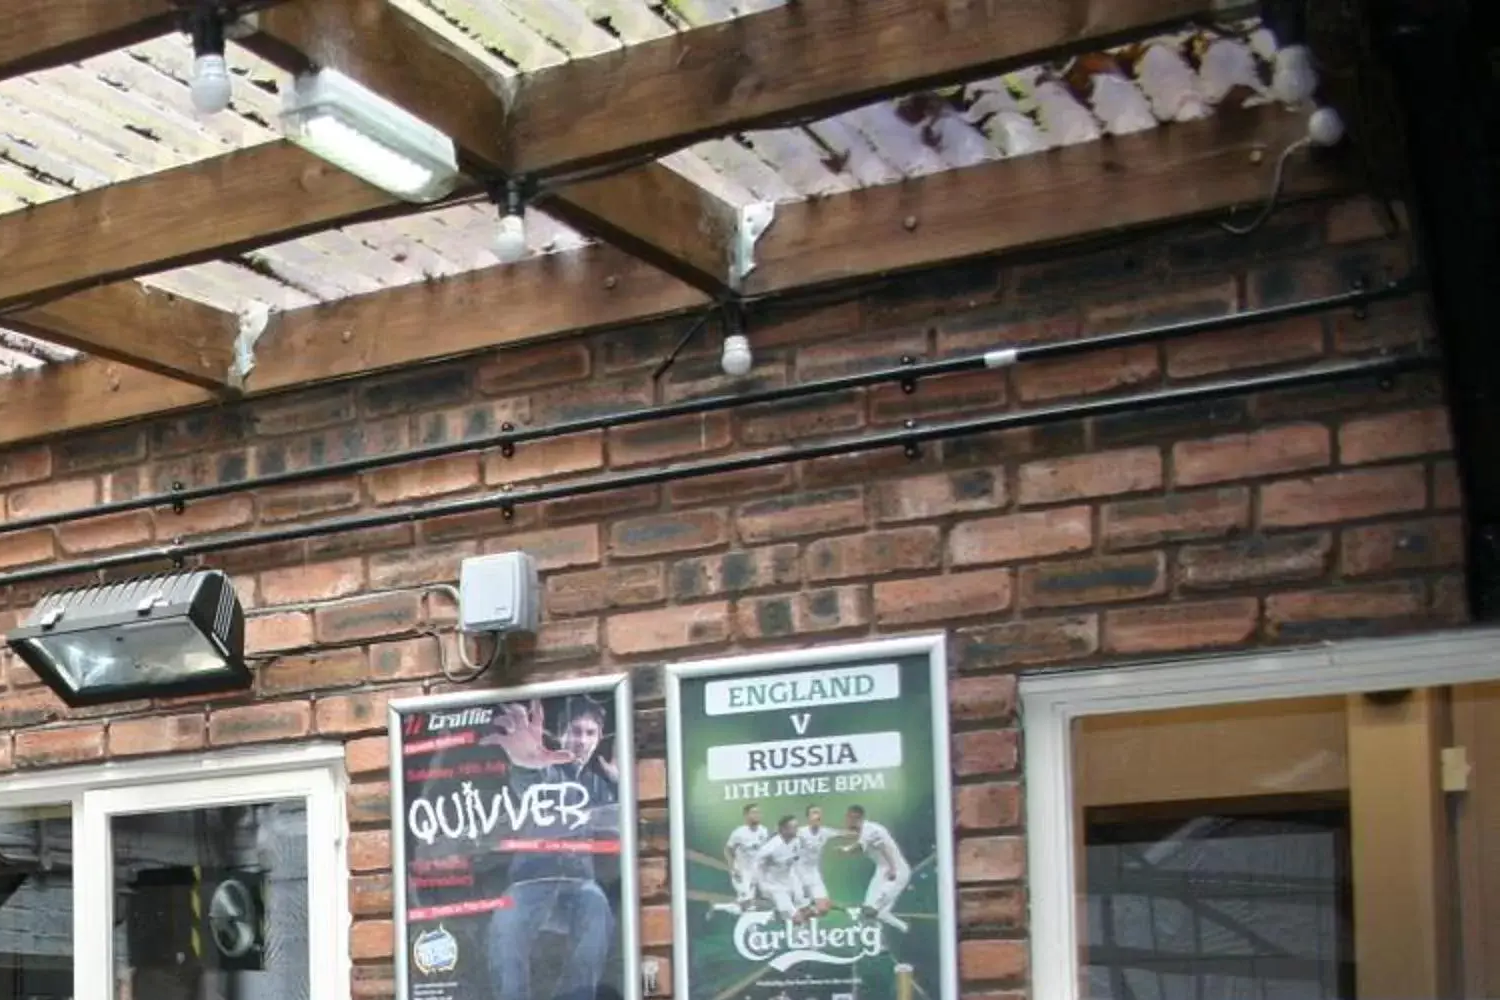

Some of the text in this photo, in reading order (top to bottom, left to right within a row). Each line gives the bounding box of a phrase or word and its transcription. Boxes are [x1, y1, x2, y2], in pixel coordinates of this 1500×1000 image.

[728, 674, 875, 708] ENGLAND
[790, 713, 812, 735] V
[748, 743, 859, 772] RUSSIA
[724, 773, 887, 801] 11TH JUNE 8PM
[733, 911, 884, 961] Carlsberg
